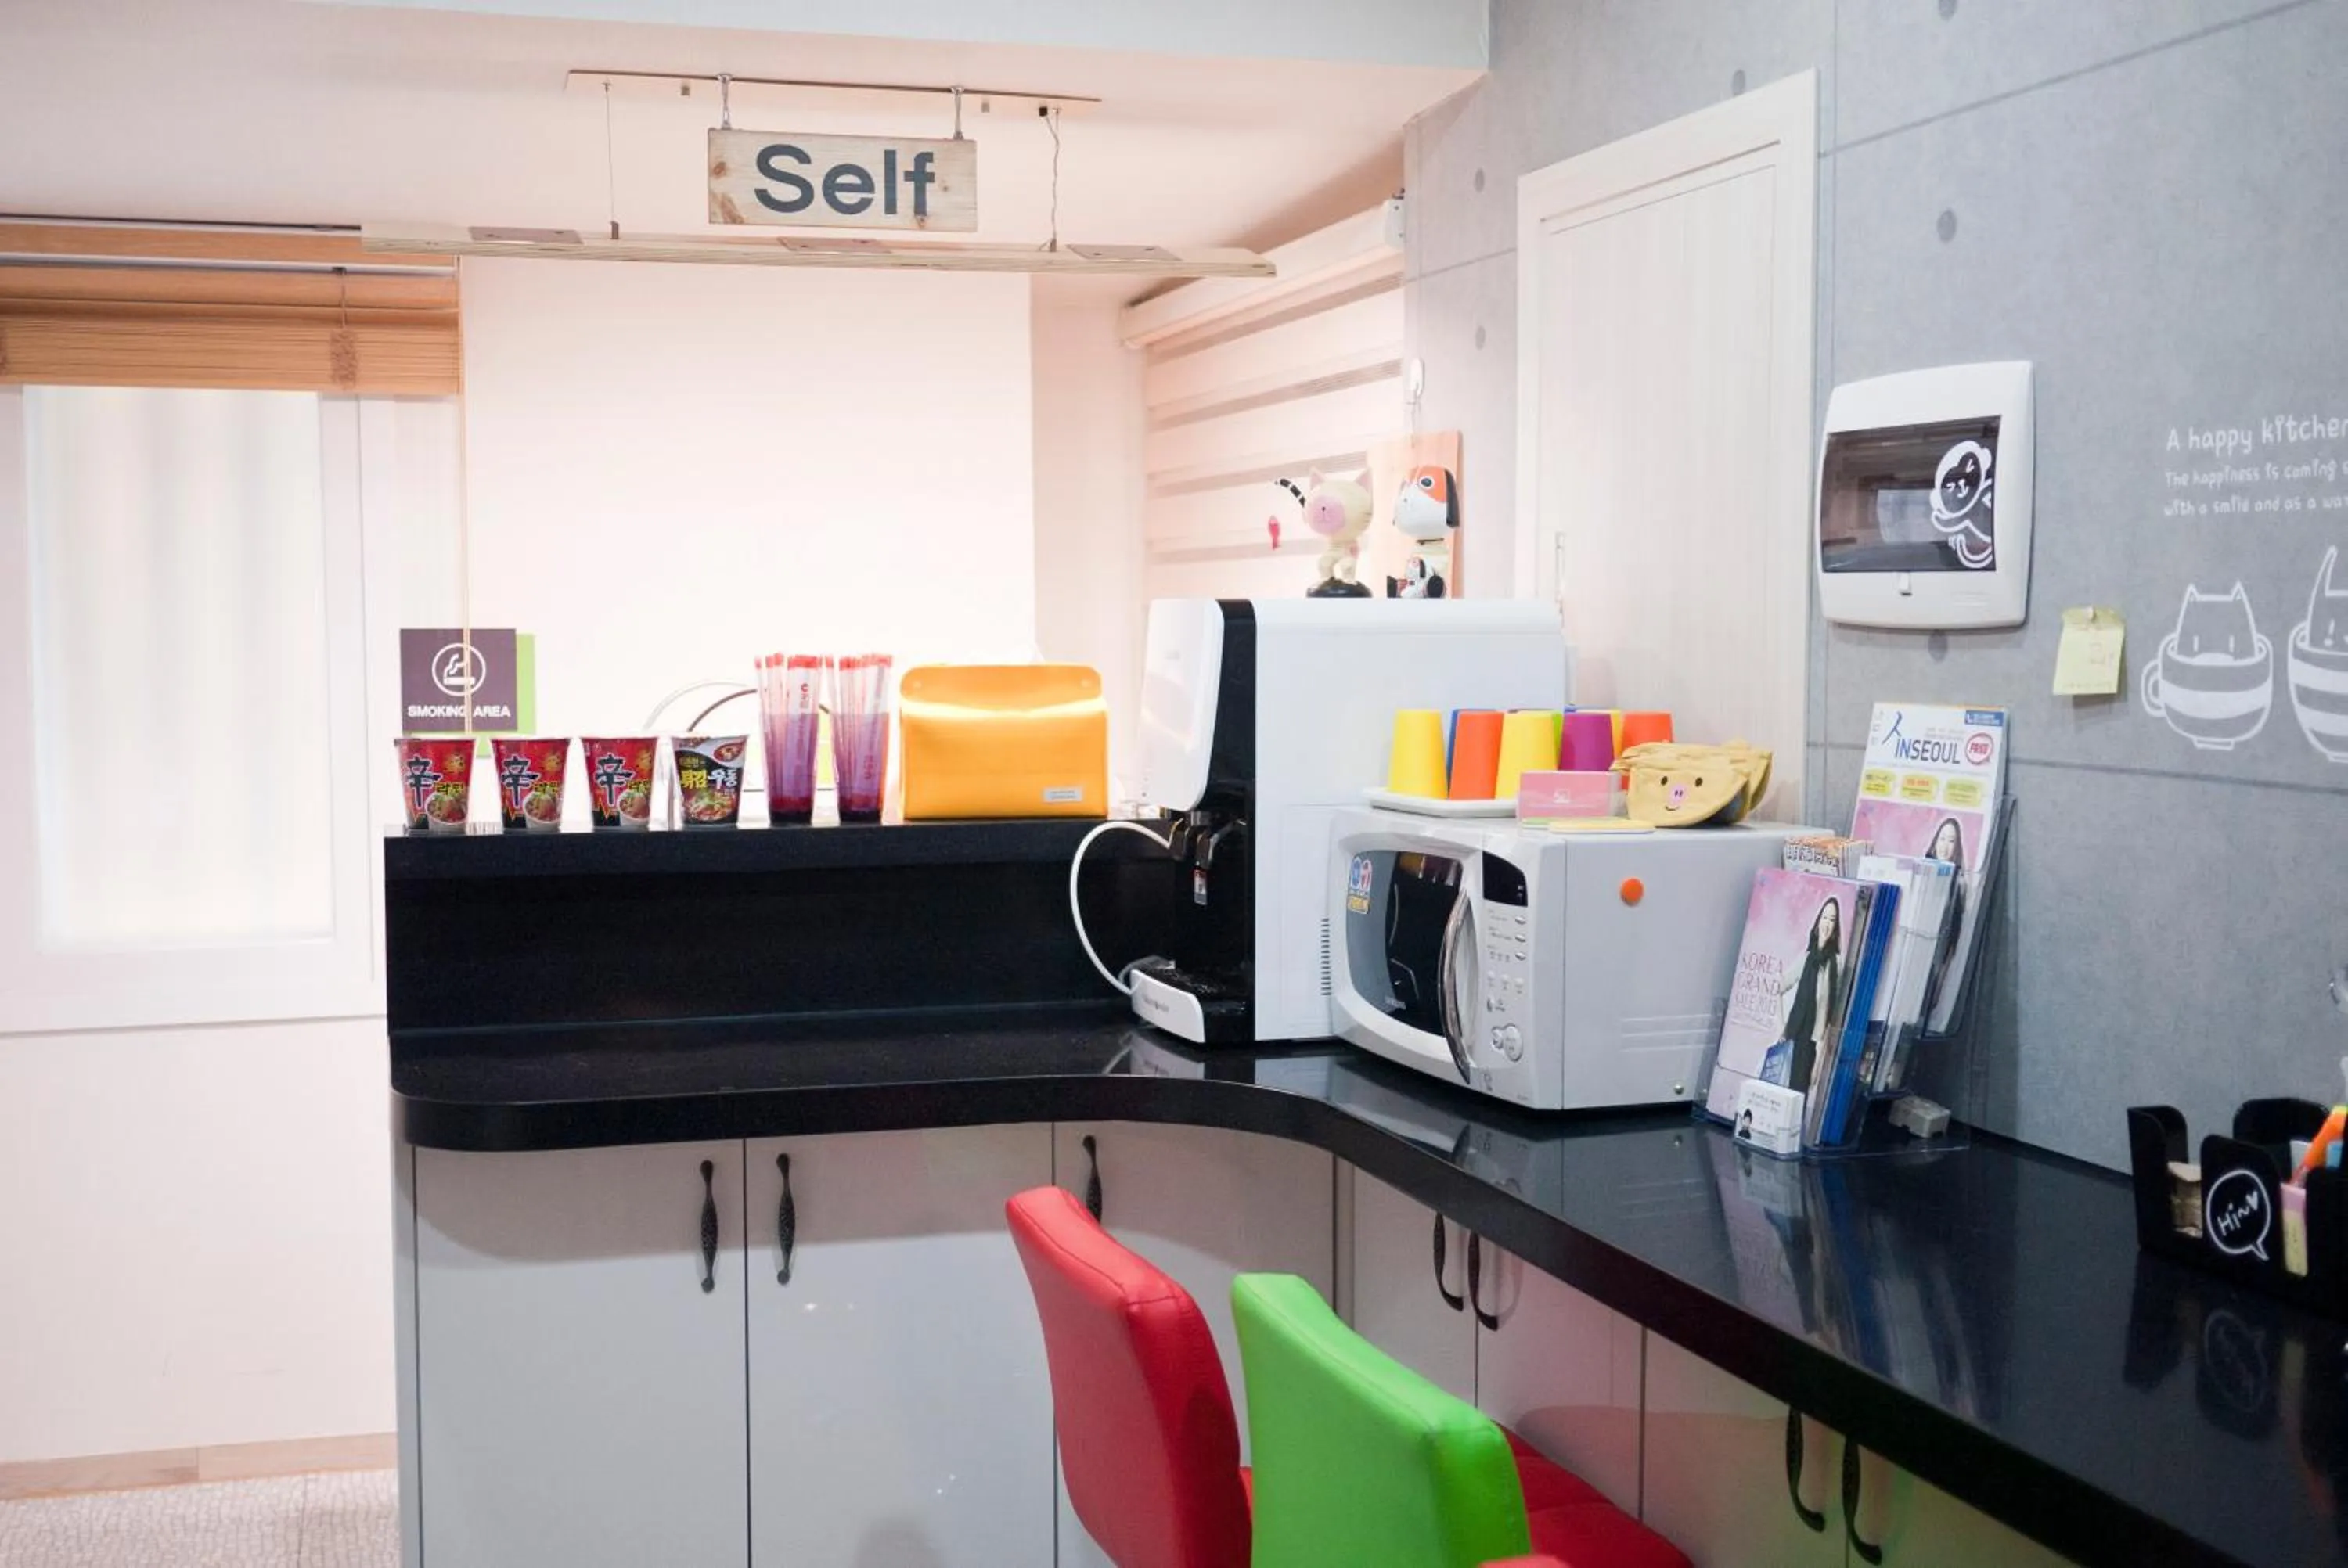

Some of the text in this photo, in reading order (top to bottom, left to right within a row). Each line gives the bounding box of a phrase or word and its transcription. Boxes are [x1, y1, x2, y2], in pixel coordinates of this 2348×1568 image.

[754, 143, 935, 217] Self
[2166, 427, 2180, 451] A
[2188, 426, 2253, 457] happy
[2165, 470, 2189, 487] The
[2192, 465, 2260, 489] happiness
[2266, 462, 2279, 480] is
[2284, 458, 2338, 482] coming
[2164, 498, 2195, 517] with
[2199, 502, 2207, 514] a
[2254, 497, 2280, 512] and
[2307, 498, 2317, 509] a
[473, 705, 511, 717] AREA
[405, 754, 442, 809] 辛
[500, 754, 540, 809] 辛
[594, 753, 635, 808] 辛
